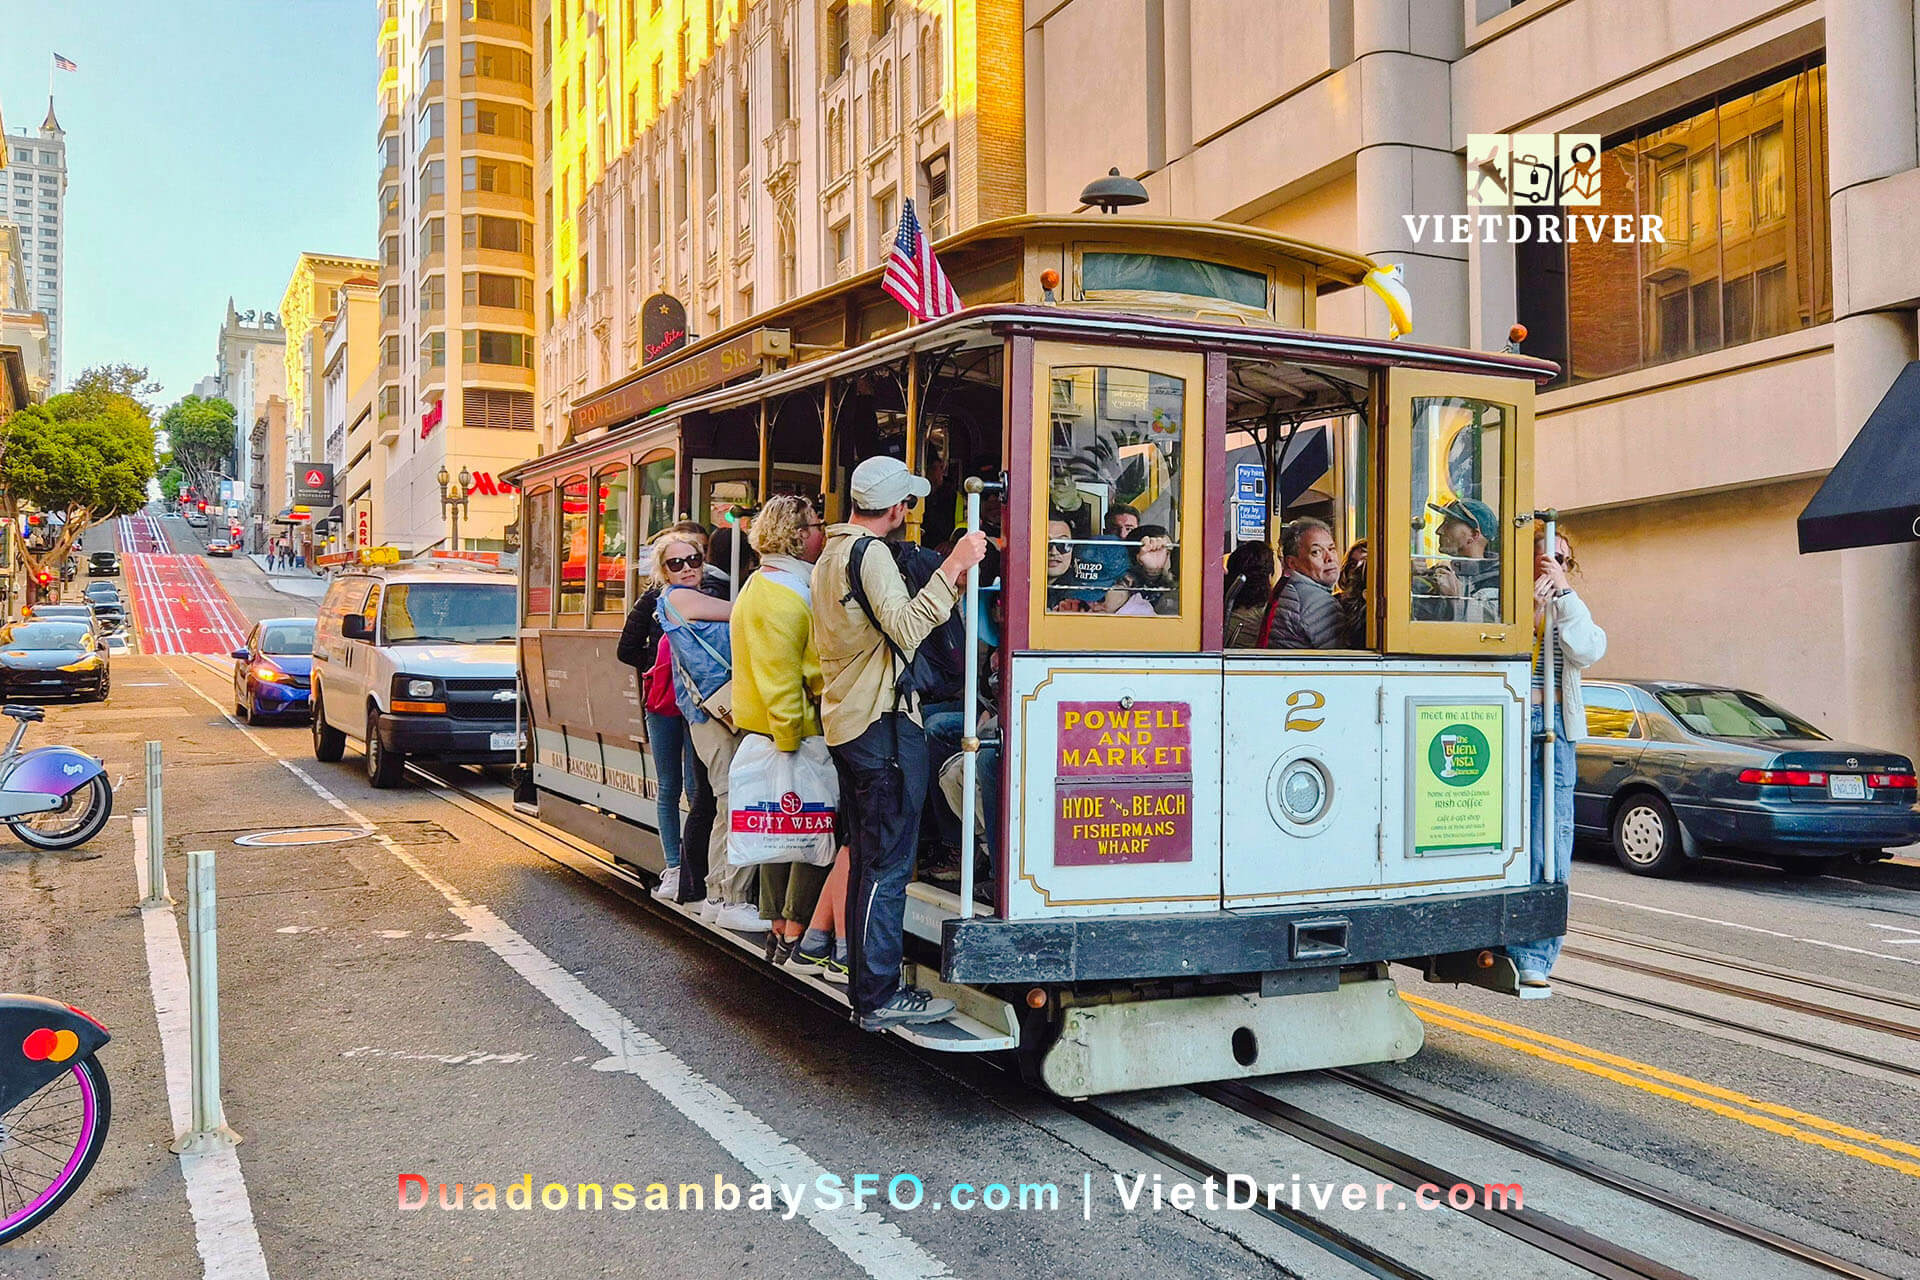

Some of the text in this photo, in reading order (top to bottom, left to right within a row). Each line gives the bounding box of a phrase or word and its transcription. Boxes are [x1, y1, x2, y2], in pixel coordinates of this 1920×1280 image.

[578, 394, 632, 427] POWELL
[663, 358, 712, 396] HYDE
[360, 512, 368, 546] PARK
[1064, 710, 1185, 730] POWELL
[1284, 689, 1326, 732] 2
[1098, 731, 1153, 746] AND
[1062, 747, 1186, 767] MARKET
[1063, 794, 1185, 819] HYDE AND BEACH
[747, 815, 833, 830] CITY WEAR
[1073, 821, 1176, 840] FISHERMANS
[1097, 839, 1151, 856] WHARF
